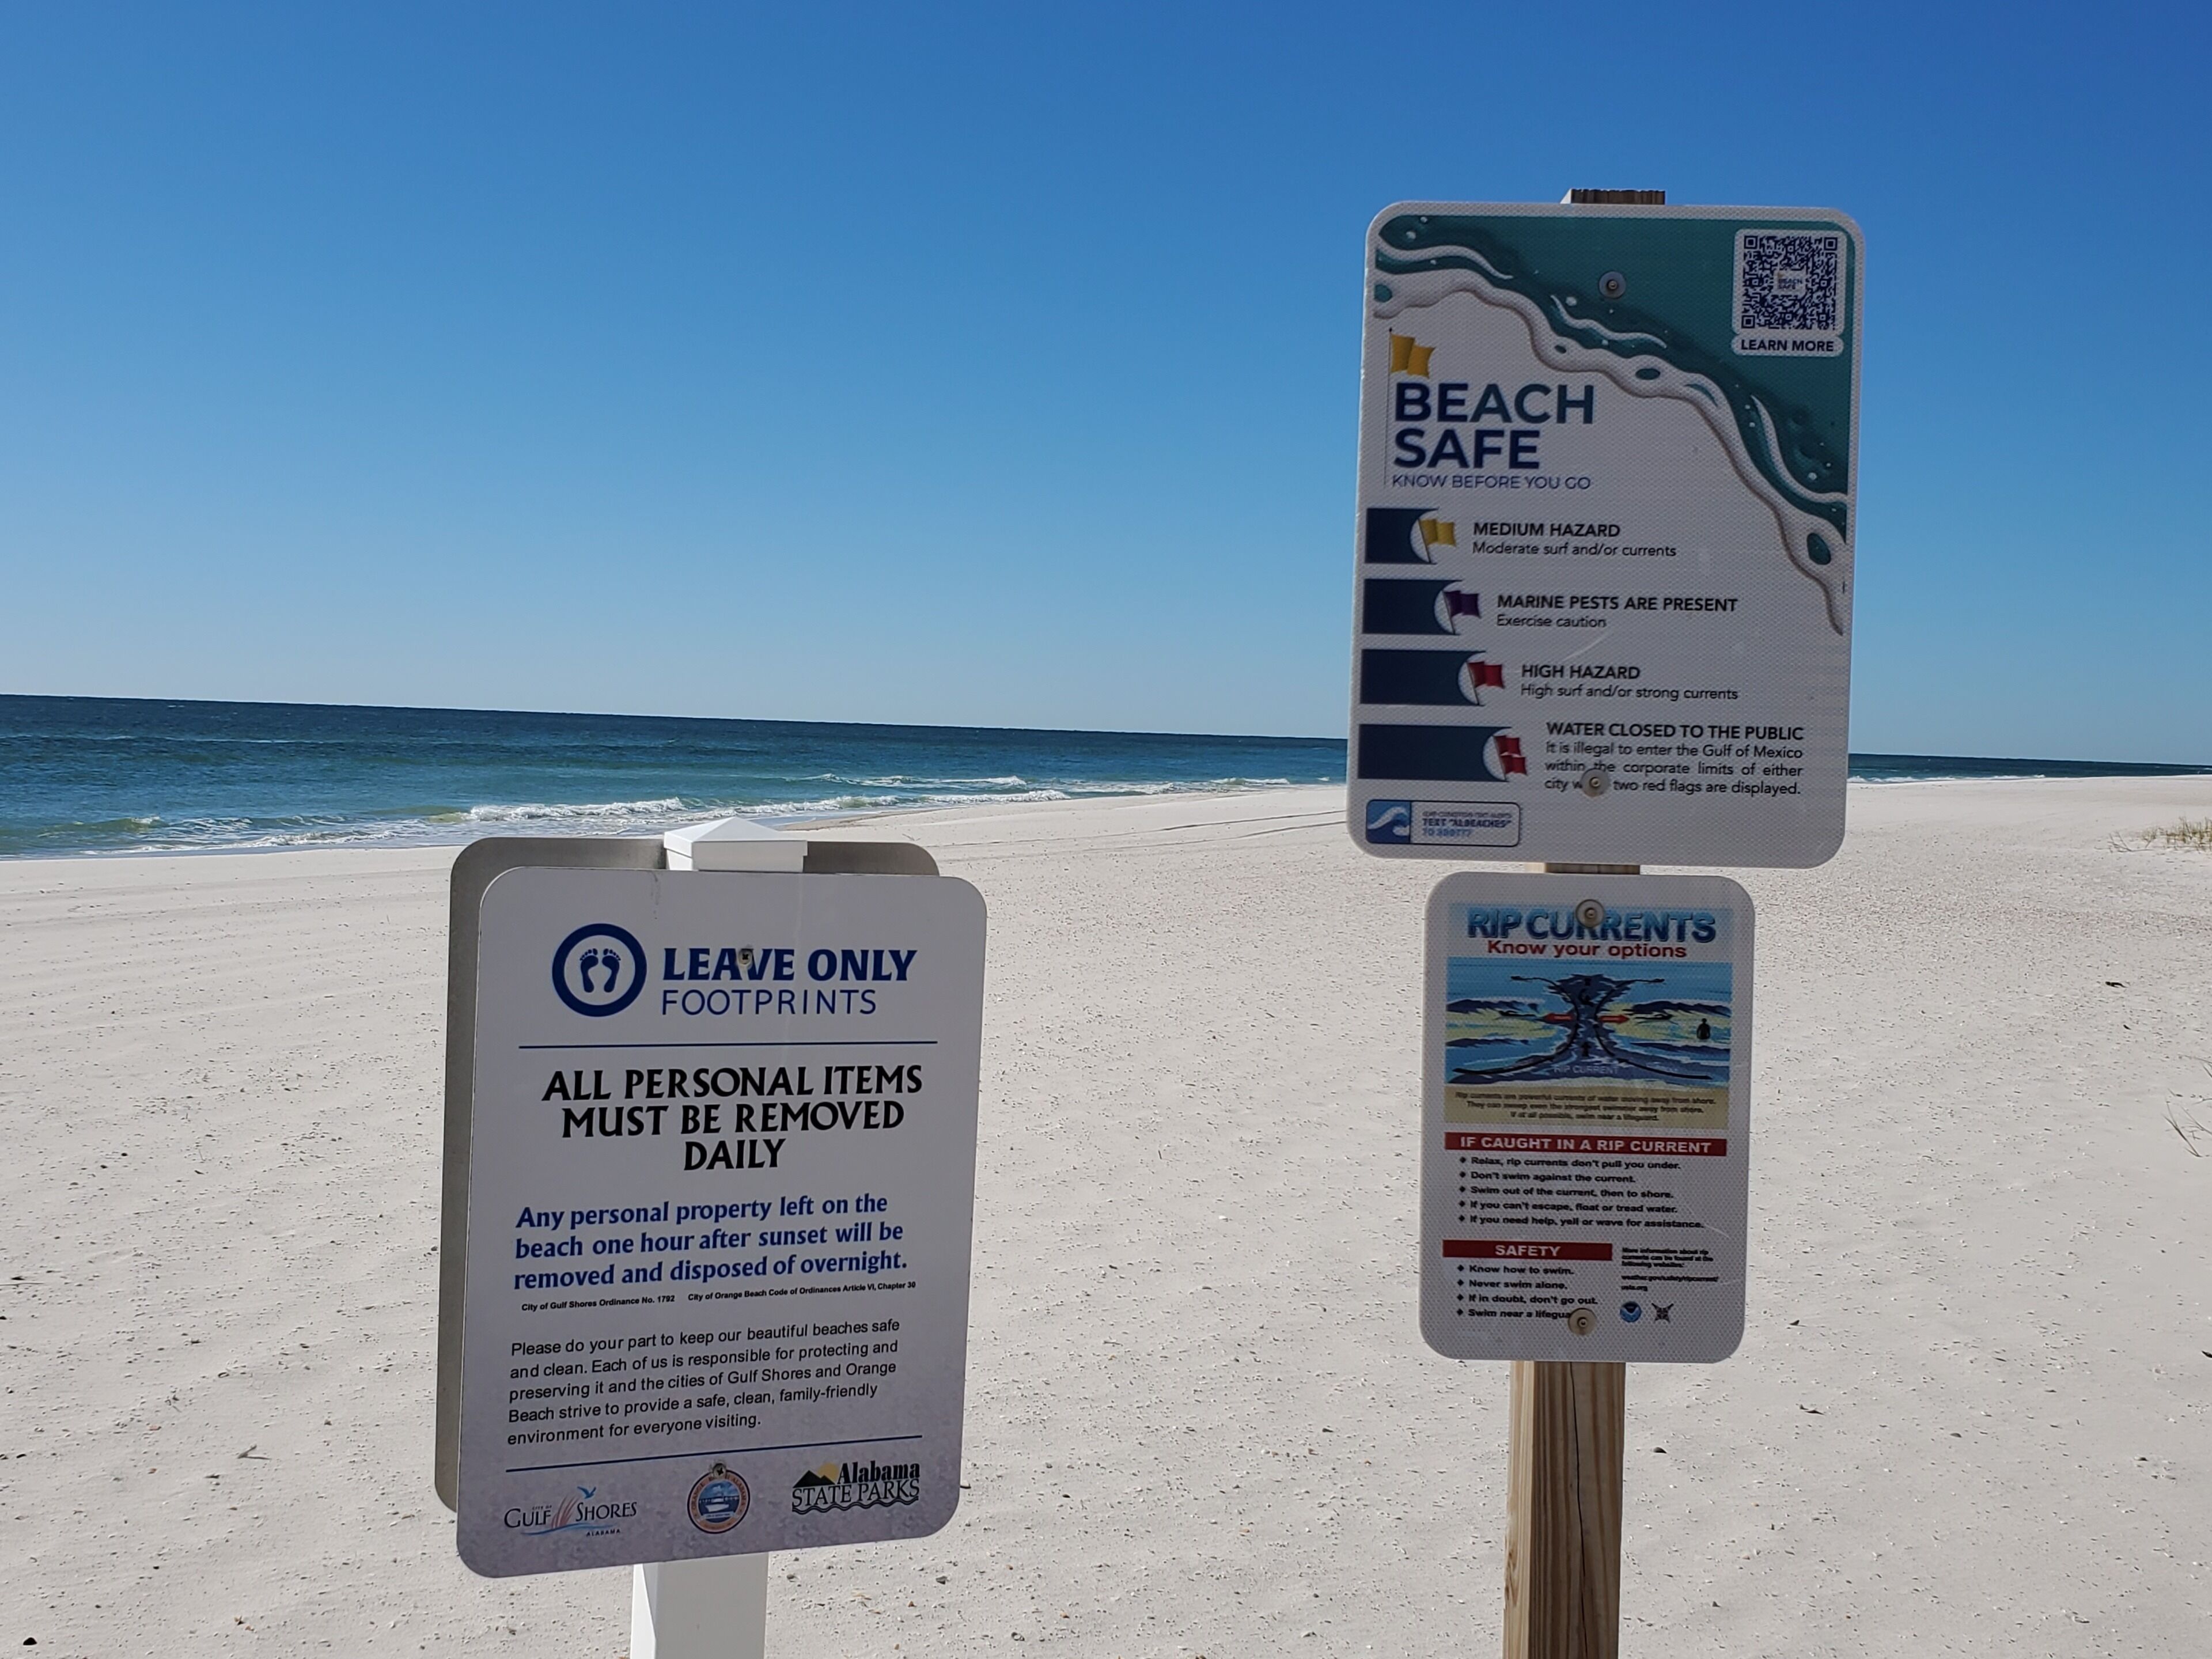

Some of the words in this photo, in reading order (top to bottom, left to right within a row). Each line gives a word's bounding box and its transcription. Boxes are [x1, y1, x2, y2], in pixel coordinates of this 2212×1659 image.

[1741, 339, 1787, 351] LEARN
[1791, 340, 1834, 352] MORE
[1395, 382, 1594, 424] BEACH
[1393, 427, 1540, 469] SAFE
[1392, 474, 1448, 488] KNOW
[1452, 475, 1521, 489] BEFORE
[1524, 476, 1560, 490] YOU
[1565, 476, 1591, 490] GO
[1474, 522, 1544, 536] MEDIUM
[1550, 523, 1620, 537] HAZARD
[1472, 541, 1540, 554] Moderate
[1543, 542, 1569, 555] surf
[1571, 543, 1618, 556] and/or
[1622, 546, 1677, 557] currents
[1497, 594, 1564, 609] MARINE
[1570, 595, 1619, 610] PESTS
[1624, 597, 1657, 611] ARE
[1663, 597, 1738, 612] PRESENT
[1497, 614, 1552, 627] Exercise
[1556, 615, 1607, 628] caution
[1522, 664, 1565, 678] HIGH
[1570, 665, 1641, 680] HAZARD
[1521, 683, 1554, 699] High
[1557, 684, 1584, 696] surf
[1586, 684, 1633, 698] and/or
[1636, 688, 1679, 702] strong
[1684, 689, 1738, 700] currents
[1546, 722, 1604, 736] WATER
[1608, 723, 1676, 737] CLOSED
[1679, 725, 1704, 738] TO
[1707, 725, 1740, 739] THE
[1745, 726, 1804, 741] PUBLIC
[1546, 741, 1556, 753] It
[1559, 741, 1570, 753] is
[1574, 741, 1614, 757] illegal
[1618, 744, 1633, 755] to
[1636, 745, 1673, 756] enter
[1675, 743, 1699, 756] the
[1702, 744, 1733, 757] Gulf
[1735, 744, 1750, 757] of
[1753, 745, 1804, 759] Mexico
[1545, 759, 1585, 771] within
[1593, 760, 1616, 772] the
[1623, 764, 1690, 777] corporate
[1698, 762, 1734, 775] limits
[1741, 763, 1756, 775] of
[1762, 763, 1804, 777] either
[1544, 777, 1569, 793] city
[1613, 781, 1639, 791] two
[1642, 779, 1666, 791] red
[1669, 778, 1702, 794] flags
[1706, 783, 1728, 793] are
[1731, 780, 1801, 796] displayed.
[1467, 907, 1521, 939] RIP
[1488, 941, 1547, 955] Know
[1553, 944, 1601, 959] your
[1608, 943, 1687, 960] options
[663, 948, 794, 981] LEAVE
[808, 949, 918, 981] ONLY
[662, 989, 876, 1016] FOOTPRINTS
[541, 1070, 611, 1101] ALL
[624, 1066, 814, 1099] PERSONAL
[824, 1065, 922, 1095] ITEMS
[562, 1105, 669, 1138] MUST
[680, 1104, 721, 1134] BE
[735, 1100, 904, 1133] REMOVED
[684, 1138, 786, 1171] DAILY
[1461, 1137, 1476, 1147] IF
[1481, 1137, 1552, 1149] CAUGHT
[1557, 1139, 1574, 1150] IN
[1580, 1139, 1592, 1150] A
[1597, 1139, 1624, 1151] RIP
[1630, 1141, 1711, 1153] CURRENT
[1471, 1157, 1503, 1166] Relax,
[1506, 1157, 1521, 1167] rip
[1571, 1159, 1599, 1168] don't
[1601, 1160, 1622, 1169] pull
[1624, 1162, 1645, 1170] you
[1647, 1161, 1681, 1169] under.
[1471, 1171, 1499, 1180] Don't
[1502, 1172, 1531, 1180] swim
[1532, 1173, 1572, 1183] against
[1574, 1174, 1592, 1182] the
[1594, 1175, 1636, 1183] current.
[515, 1207, 565, 1231] Any
[570, 1201, 669, 1230] personal
[676, 1200, 772, 1225] property
[780, 1195, 814, 1216] left
[822, 1199, 848, 1214] on
[855, 1193, 888, 1213] the
[516, 1235, 582, 1259] beach
[592, 1238, 634, 1255] one
[641, 1232, 695, 1252] hour
[699, 1228, 751, 1249] after
[759, 1226, 828, 1247] sunset
[835, 1221, 872, 1243] will
[879, 1221, 903, 1241] be
[1495, 1245, 1560, 1256] SAFETY
[514, 1264, 615, 1290] removed
[622, 1261, 663, 1283] and
[670, 1255, 767, 1283] disposed
[773, 1254, 797, 1275] of
[801, 1249, 907, 1274] overnight.
[1469, 1264, 1500, 1273] Know
[1503, 1266, 1527, 1274] how
[1528, 1266, 1540, 1274] to
[1543, 1267, 1574, 1275] swim.
[688, 1293, 703, 1302] City
[705, 1292, 713, 1300] of
[744, 1290, 767, 1298] Beach
[768, 1288, 788, 1296] Code
[799, 1286, 841, 1294] Ordinances
[842, 1284, 866, 1292] Article
[877, 1282, 906, 1291] Chapter
[1469, 1279, 1501, 1288] Never
[1503, 1280, 1532, 1289] swim
[1535, 1281, 1568, 1290] alone.
[521, 1304, 538, 1312] City
[540, 1302, 548, 1310] of
[550, 1301, 567, 1309] Gulf
[599, 1298, 640, 1306] Ordinance
[657, 1295, 675, 1303] 1792
[512, 1342, 562, 1357] Please
[565, 1339, 585, 1353] do
[589, 1339, 624, 1354] your
[628, 1334, 657, 1352] part
[661, 1334, 674, 1346] to
[680, 1331, 714, 1346] keep
[718, 1331, 742, 1342] our
[747, 1324, 808, 1340] beautiful
[813, 1321, 868, 1336] beaches
[872, 1318, 900, 1332] safe
[507, 1425, 604, 1445] environment
[609, 1423, 630, 1437] for
[634, 1419, 702, 1435] everyone
[705, 1414, 761, 1429] visiting.
[837, 1460, 921, 1485] Alabama
[792, 1484, 852, 1508] STATE
[857, 1478, 920, 1501] PARKS
[504, 1508, 551, 1528] GULF
[575, 1502, 638, 1522] SHORES
[585, 1528, 621, 1537] ALABAMA
